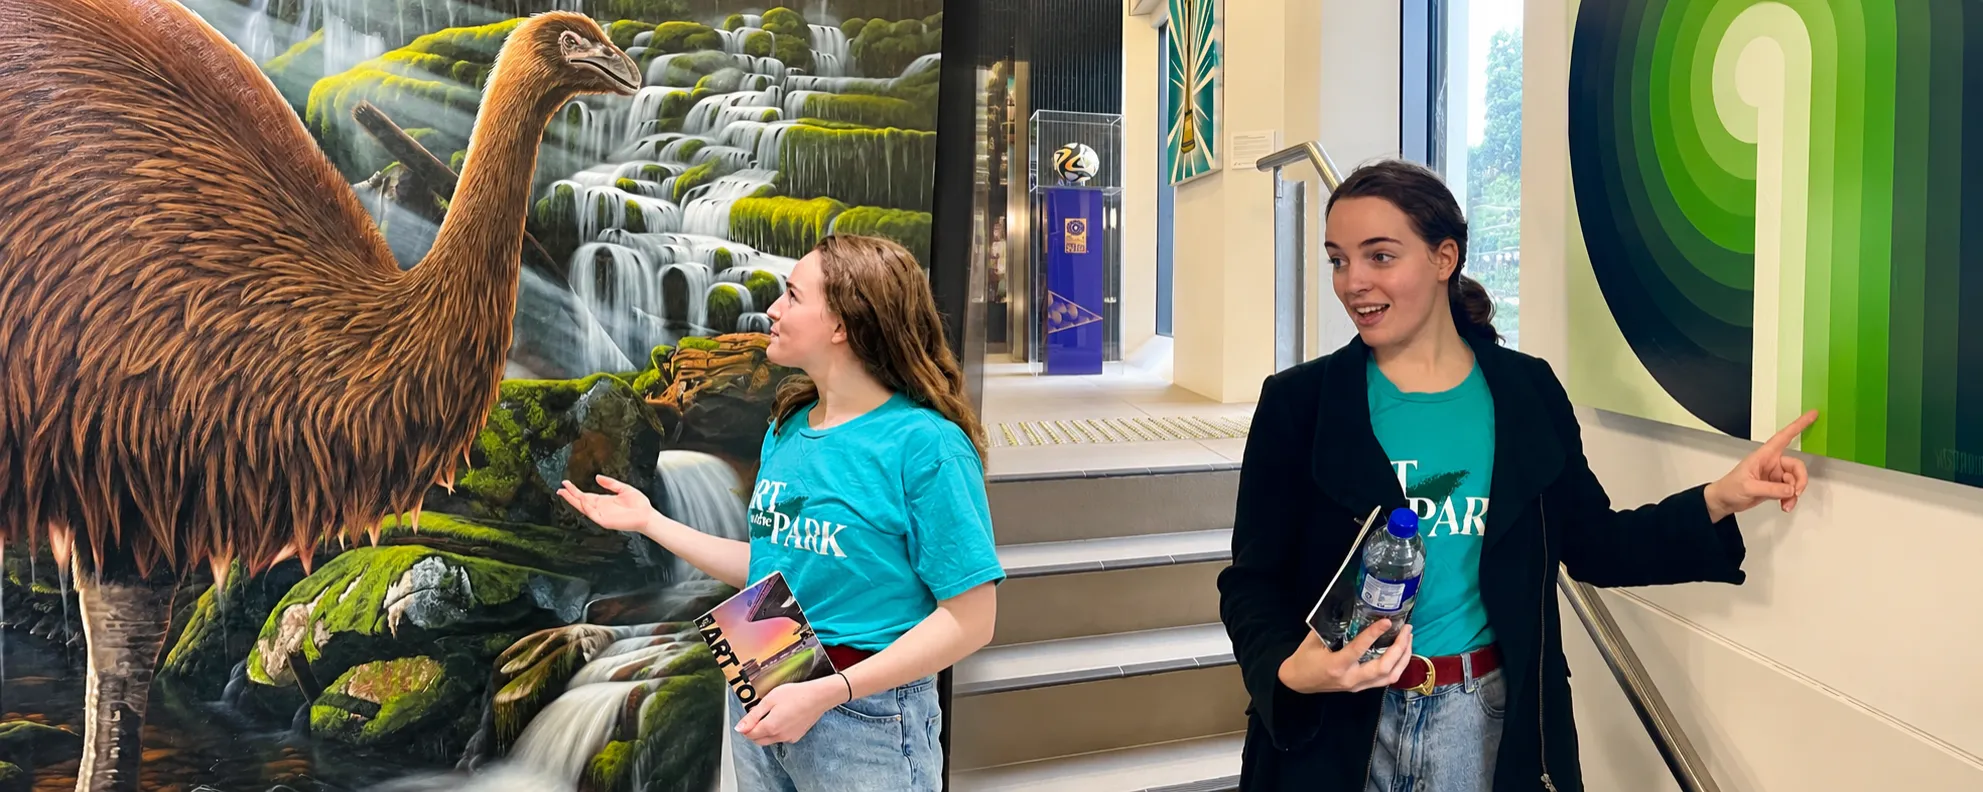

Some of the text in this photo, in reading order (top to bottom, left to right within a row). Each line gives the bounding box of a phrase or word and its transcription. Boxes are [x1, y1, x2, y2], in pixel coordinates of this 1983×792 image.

[1390, 460, 1418, 500] T
[770, 511, 848, 558] PARK
[1405, 495, 1489, 538] PAR
[700, 627, 740, 668] ART
